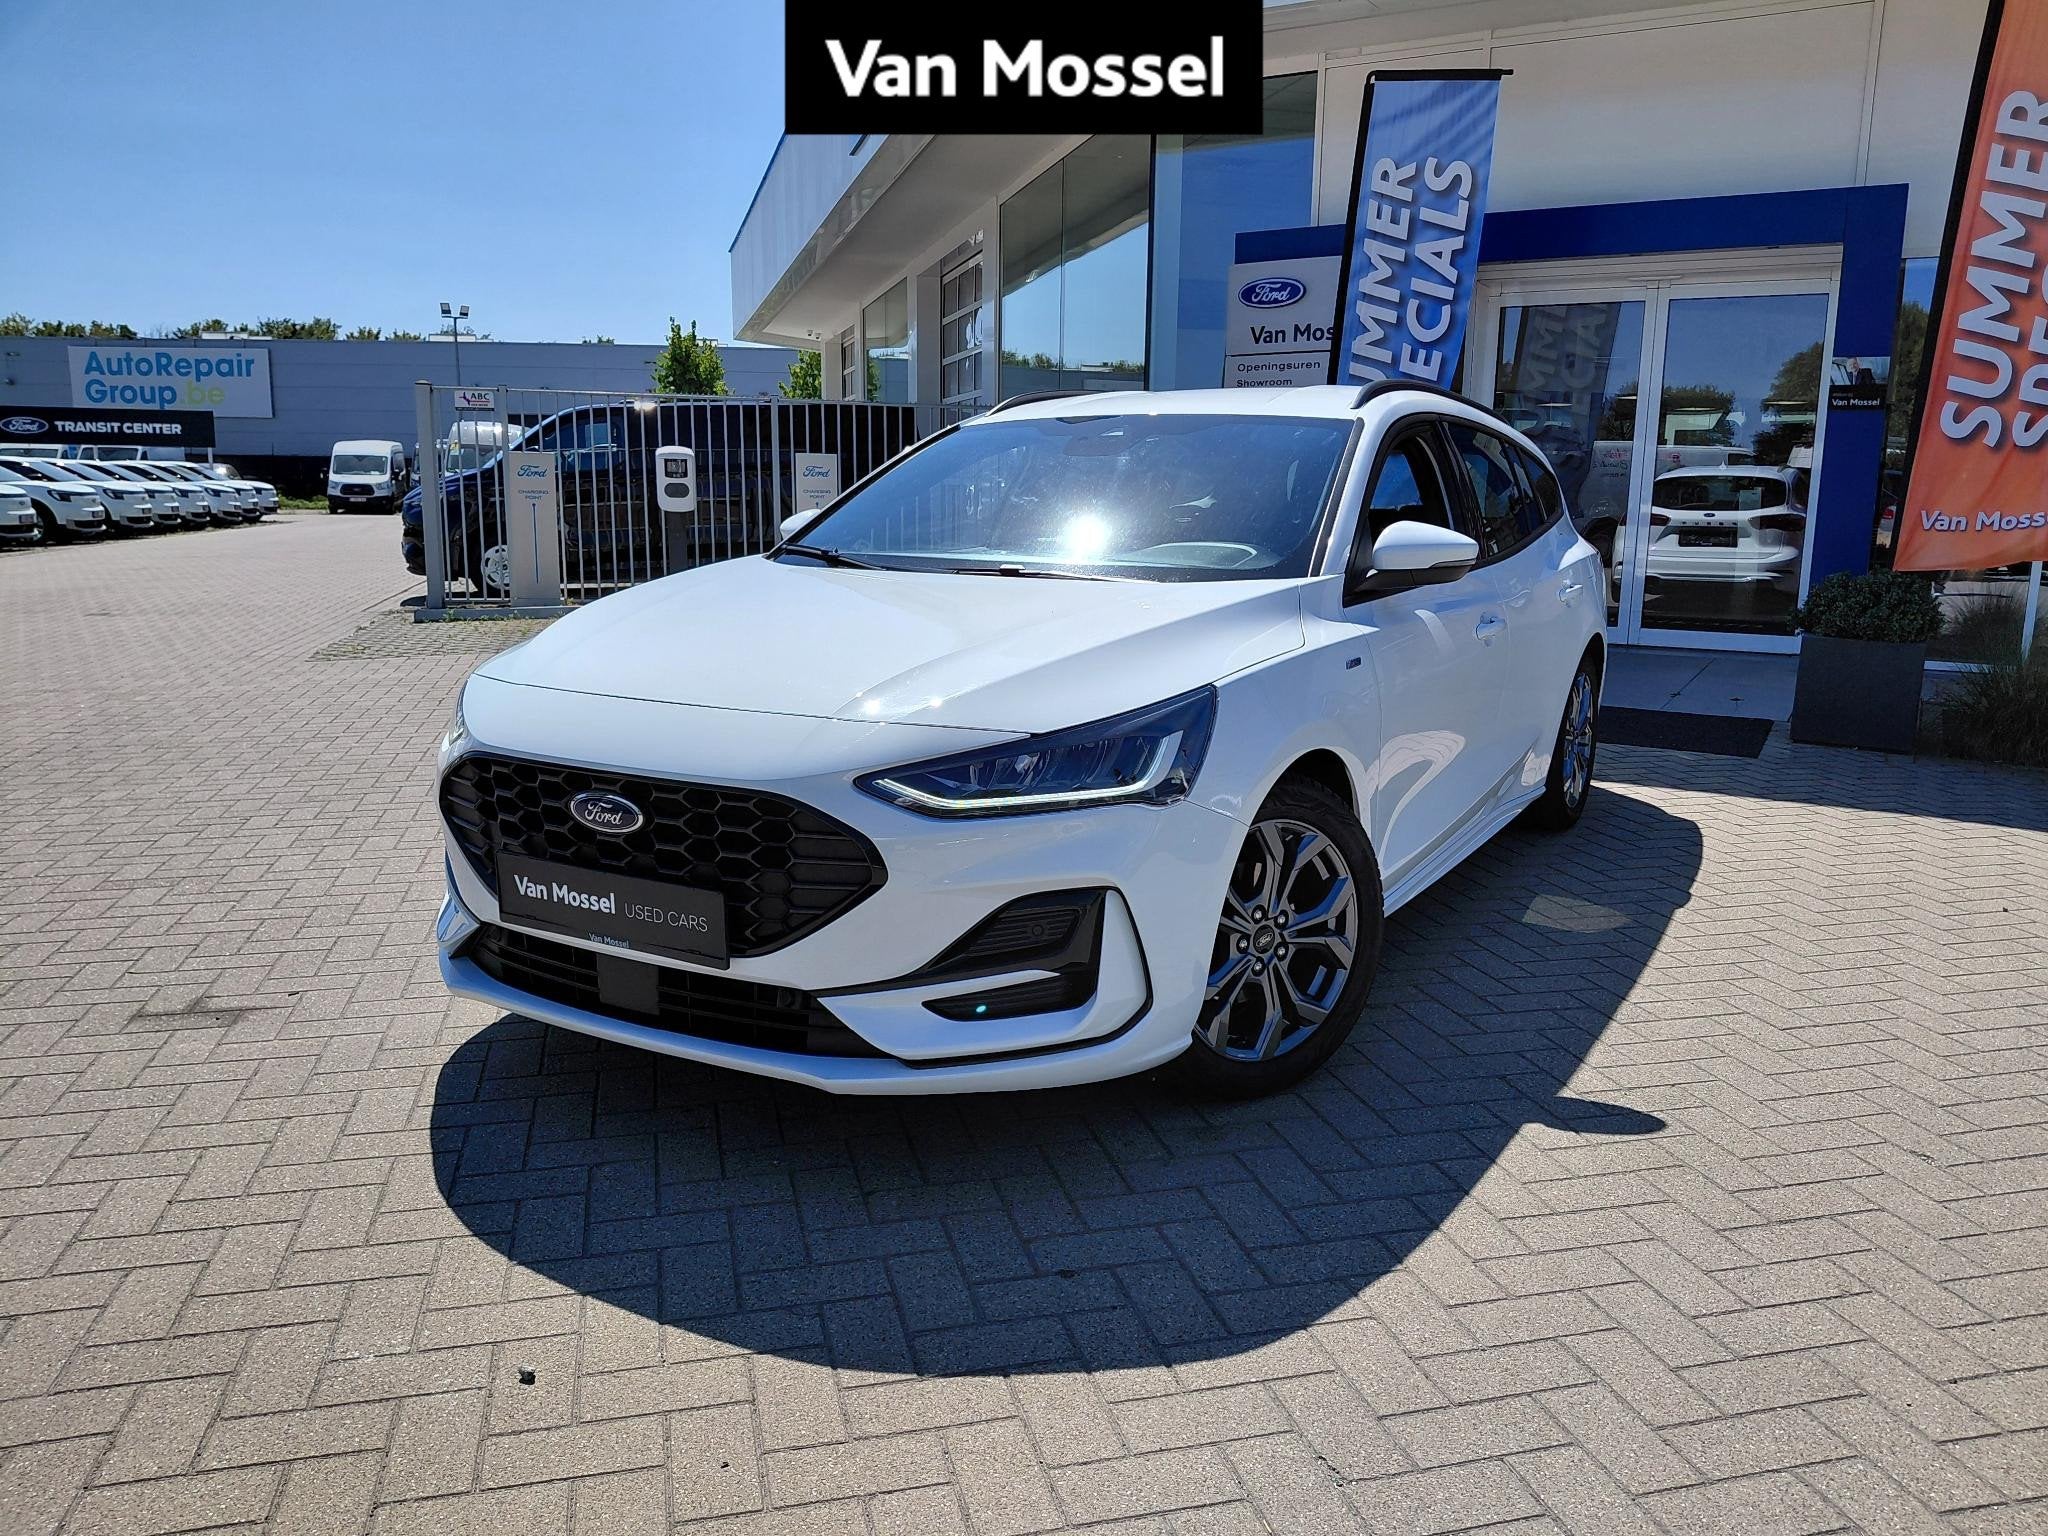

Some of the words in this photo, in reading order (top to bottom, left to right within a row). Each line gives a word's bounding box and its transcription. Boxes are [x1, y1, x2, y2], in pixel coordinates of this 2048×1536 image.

[1940, 90, 2048, 447] SUMMER
[1251, 283, 1291, 302] Ford
[1249, 325, 1286, 344] Van
[84, 351, 255, 382] AutoRepair
[1237, 361, 1321, 373] Openingsuren
[1236, 379, 1293, 388] Showroom
[470, 392, 490, 400] ABC
[1849, 398, 1880, 406] Mossel
[54, 421, 121, 433] TRANSIT
[123, 422, 182, 434] CENTER
[517, 464, 548, 478] Ford
[803, 465, 831, 478] Ford
[1921, 510, 1967, 531] Van
[1975, 511, 2048, 531] Moss
[585, 801, 623, 825] Ford
[514, 874, 547, 900] Van
[552, 882, 616, 915] Mossel
[624, 902, 664, 923] USED
[667, 911, 708, 932] CARS
[588, 932, 603, 944] Van
[603, 936, 630, 949] Mossel
